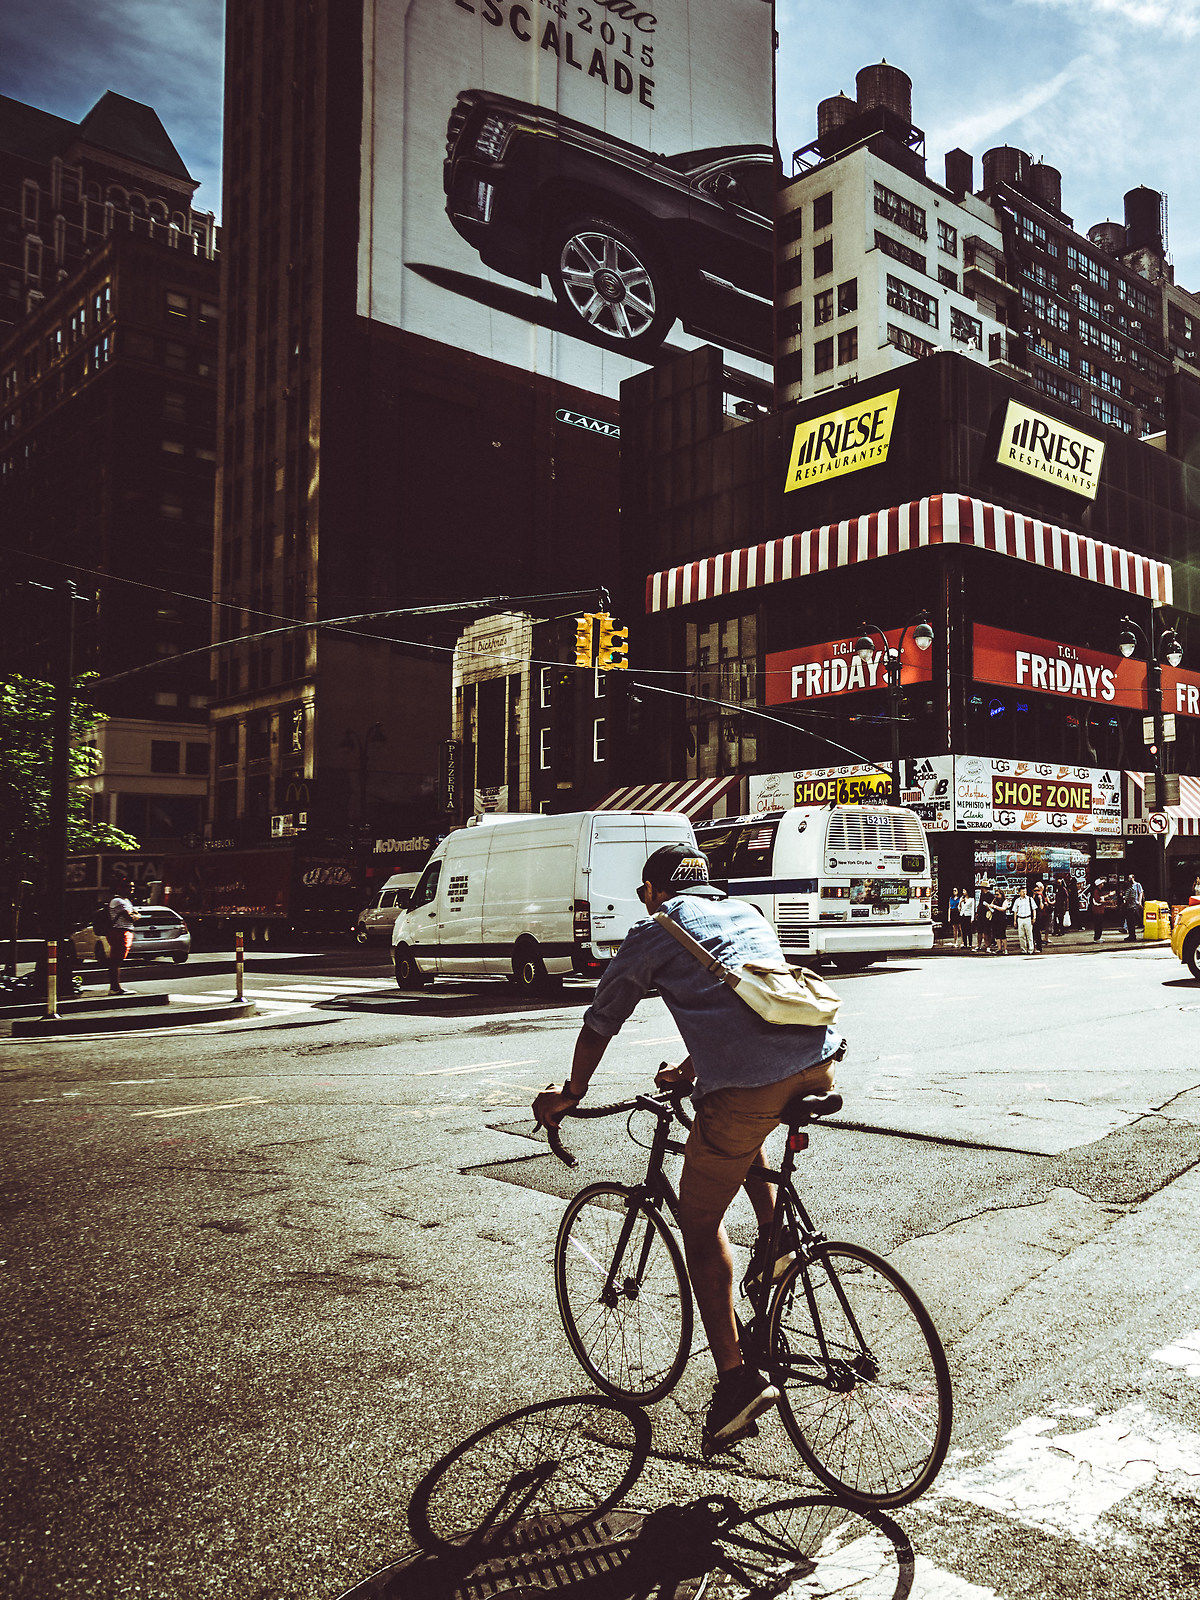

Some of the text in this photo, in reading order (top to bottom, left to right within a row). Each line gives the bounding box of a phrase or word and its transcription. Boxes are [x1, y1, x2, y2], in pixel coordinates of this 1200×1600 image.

[577, 7, 654, 68] 2015
[455, 0, 655, 110] SCALADE
[813, 406, 888, 458] RIESE
[1027, 418, 1095, 477] RIESE
[795, 447, 884, 482] RESTAURANTS
[1009, 448, 1092, 490] RESTAURANTS
[832, 641, 856, 656] T.G.I.
[1057, 645, 1079, 661] T.G.I.
[447, 744, 455, 808] PIZZERIA
[991, 759, 1010, 773] UGG
[1034, 764, 1052, 776] UGG
[1073, 767, 1090, 779] UGG
[795, 781, 836, 804] SHOE
[902, 791, 922, 803] PUMA
[994, 781, 1090, 809] SHOE ZONE
[957, 800, 985, 809] MEPHISTO
[1092, 808, 1121, 816] CONVERSE
[868, 816, 888, 825] 5213
[967, 821, 992, 829] SEBAGO
[993, 810, 1016, 826] UGG
[1046, 813, 1068, 827] UGG
[375, 837, 430, 853] McDonald's
[671, 868, 708, 881] WARS
